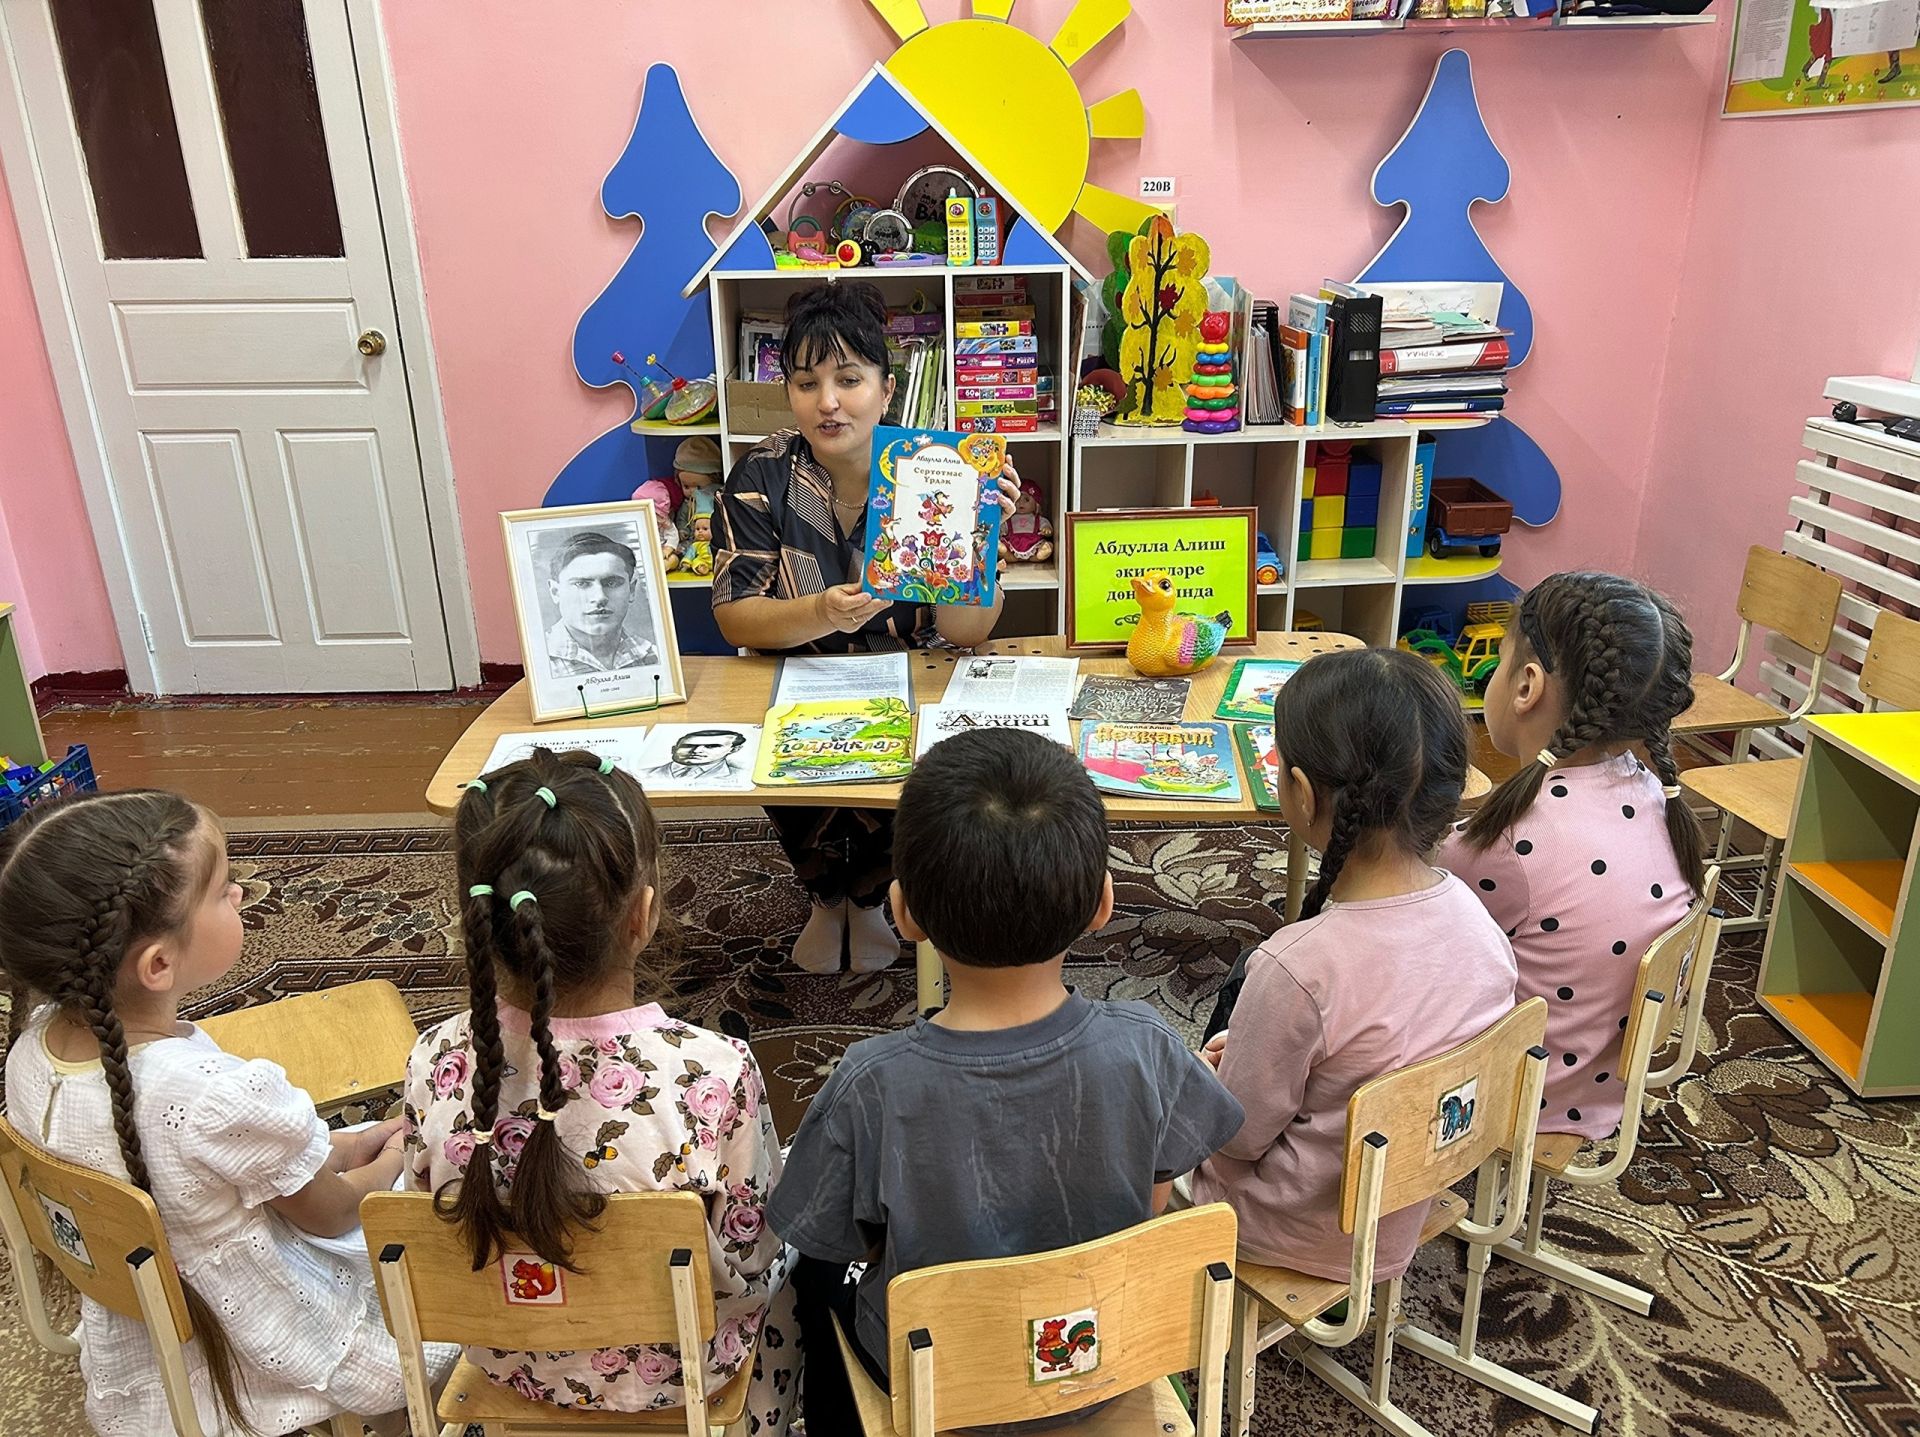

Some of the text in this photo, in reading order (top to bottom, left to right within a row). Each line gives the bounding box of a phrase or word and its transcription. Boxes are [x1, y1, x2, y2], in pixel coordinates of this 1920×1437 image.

[1143, 181, 1171, 192] 220В
[916, 455, 942, 464] Абдулла
[913, 466, 963, 477] Сертотмас
[1414, 463, 1424, 510] СТРОЙКА
[1094, 538, 1225, 557] Абдулла Алиш
[1116, 565, 1204, 579] әкиләре
